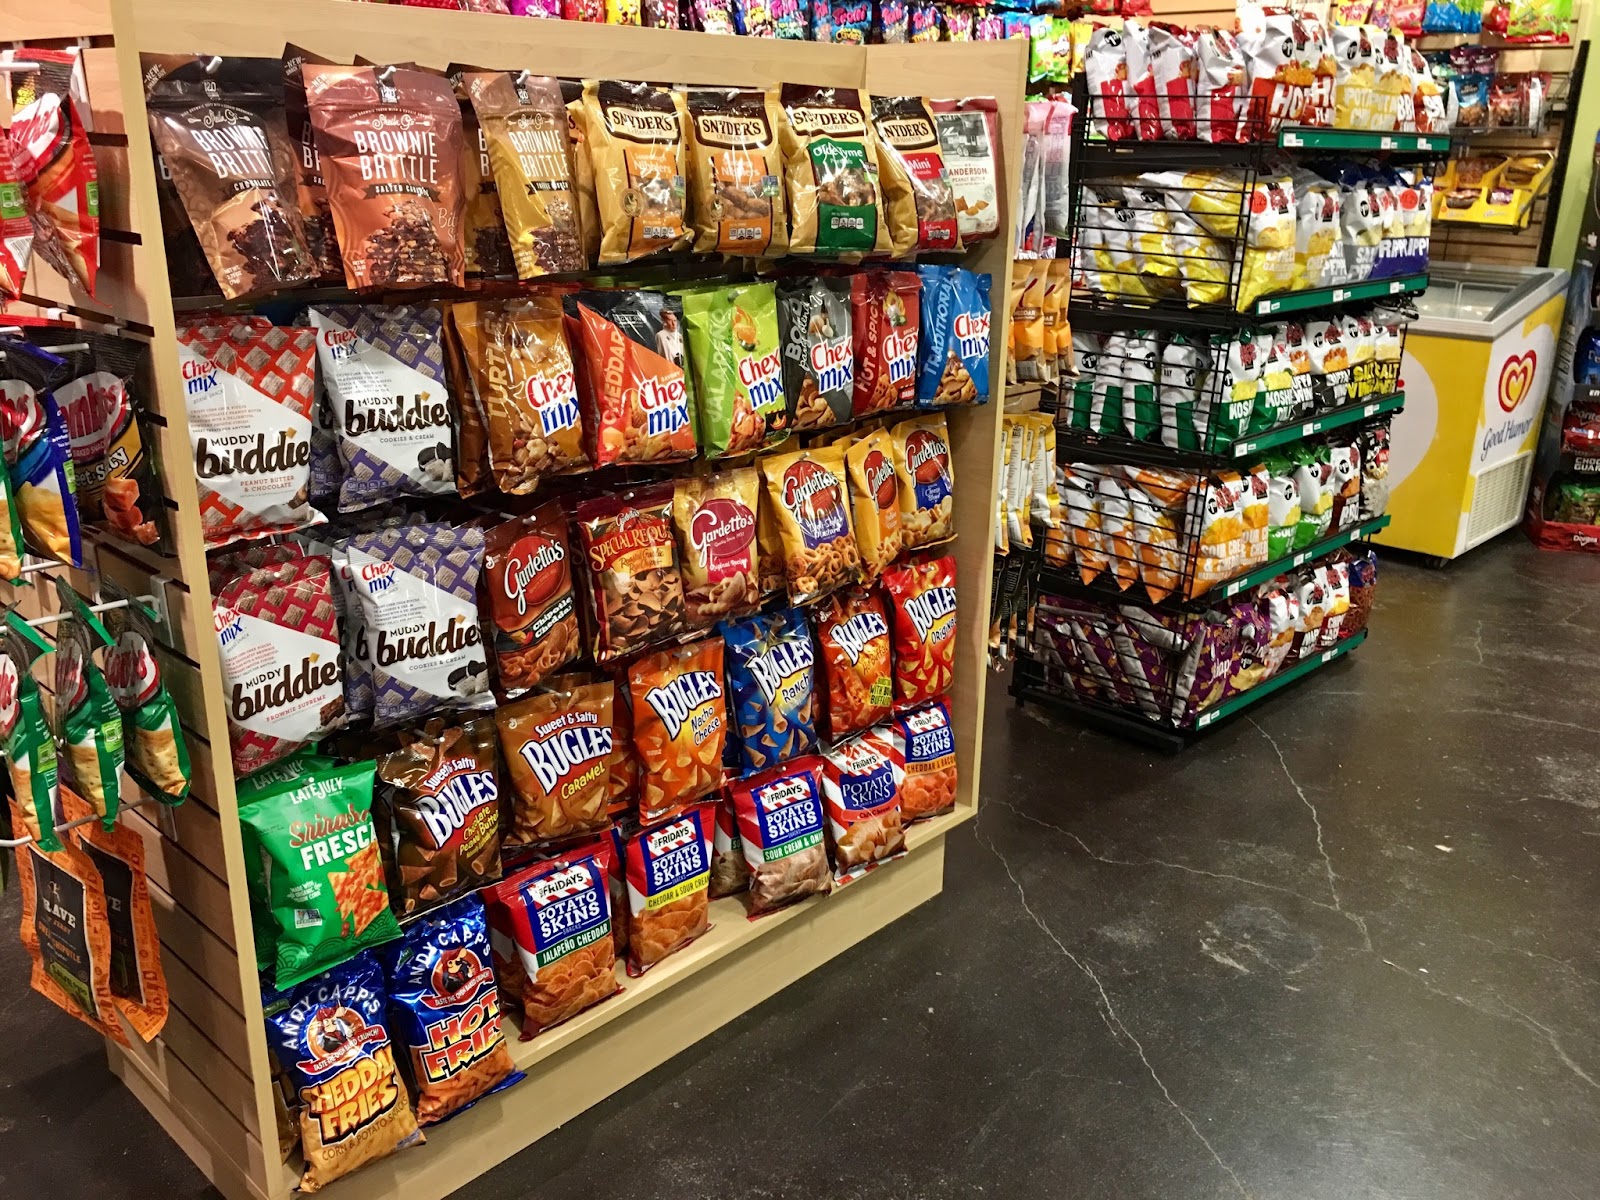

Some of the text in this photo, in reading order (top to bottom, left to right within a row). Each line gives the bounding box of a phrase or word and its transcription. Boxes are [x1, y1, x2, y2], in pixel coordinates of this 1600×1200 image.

[612, 110, 674, 131] SNYDER'S
[702, 118, 762, 135] SNYDER'S
[353, 130, 438, 157] BROWNIE
[508, 130, 565, 153] BROWNIE
[360, 154, 438, 184] BRITTLE
[519, 153, 570, 178] BRITTLE
[910, 159, 931, 171] Mini
[949, 168, 988, 176] ANDERSON
[375, 183, 404, 193] SALTED
[324, 327, 358, 347] Chex
[785, 297, 801, 362] BOLD
[923, 276, 952, 376] TRADITIONAL
[953, 310, 991, 336] Chex
[810, 336, 854, 372] Chex
[855, 299, 879, 393] HOT & SPICY
[882, 330, 919, 364] Chex
[959, 334, 990, 359] mix
[182, 358, 218, 380] Chex
[601, 331, 626, 425] CHEDDAR
[738, 349, 782, 386] Chex
[818, 362, 854, 395] mix
[889, 355, 917, 384] mix
[188, 370, 218, 395] mix
[525, 371, 578, 411] Chex
[638, 375, 688, 411] Chex
[747, 377, 784, 413] mix
[358, 396, 394, 407] MUDDY
[540, 396, 580, 437] mix
[647, 401, 691, 437] mix
[211, 434, 255, 446] MUDDY
[380, 435, 408, 444] COOKIES
[1480, 417, 1534, 463] Good Humor
[905, 440, 948, 489] Gardetto's
[240, 475, 295, 487] PEANUT BUTTER
[251, 481, 292, 492] CHOCOLATE
[782, 471, 840, 525] Gardetto's
[590, 527, 633, 571] SPECIAL
[690, 509, 755, 568] Gardetto's
[1573, 535, 1598, 544] Doritos
[362, 558, 395, 581] Chex
[368, 571, 396, 593] mix
[504, 539, 565, 615] Gardetto's
[214, 604, 241, 633] Chex
[532, 595, 574, 632] Chipotle
[534, 604, 574, 639] Cheddar
[220, 617, 243, 645] mix
[390, 623, 426, 637] MUDDY
[830, 611, 889, 667] BUGLES
[409, 661, 438, 671] COOKIES
[446, 655, 467, 664] CREAM
[748, 639, 815, 707] BUGLES
[245, 668, 282, 689] MUDDY
[782, 672, 811, 704] Ranch
[266, 694, 327, 722] BROWNIE SUPREME
[644, 670, 722, 743] BUGLES
[691, 706, 714, 732] Nacho
[534, 710, 598, 739] Sweet & Salty
[694, 718, 721, 748] Cheese
[912, 728, 950, 748] POTATO
[519, 727, 613, 796] BUGLES
[912, 738, 951, 757] SKINS
[424, 757, 476, 791] Sweet Salty
[852, 755, 877, 771] FRIDAYS
[907, 762, 936, 775] CHEDDAR
[289, 777, 344, 805] LATE JULY
[560, 761, 607, 800] Caramel
[770, 784, 804, 803] FRIDAYS
[842, 771, 894, 798] POTATO
[418, 770, 499, 850] BUGLES
[850, 787, 892, 809] SKINS
[765, 801, 815, 828] POTATO
[768, 810, 818, 839] SKINS
[657, 826, 690, 848] FRIDAYS
[651, 843, 700, 874] POTATO
[765, 847, 784, 863] SOUR
[783, 841, 803, 858] CREAM
[543, 872, 584, 896] FRIDAYS
[653, 855, 702, 886] SKINS
[537, 890, 598, 926] POTATO
[648, 892, 675, 909] CHEDDAR
[680, 882, 694, 896] SOUR
[540, 901, 601, 939] SKINS
[408, 924, 491, 985] ANDY CAPP'S
[542, 922, 609, 964] JALAPEÑO CHEDDAR
[282, 984, 381, 1051] ANDY CAPP'S
[430, 991, 498, 1046] HOT
[323, 1077, 399, 1139] FRIES
[322, 1143, 348, 1162] CORN
[356, 1118, 388, 1146] POTATO
[387, 1097, 409, 1124] SNACKS
